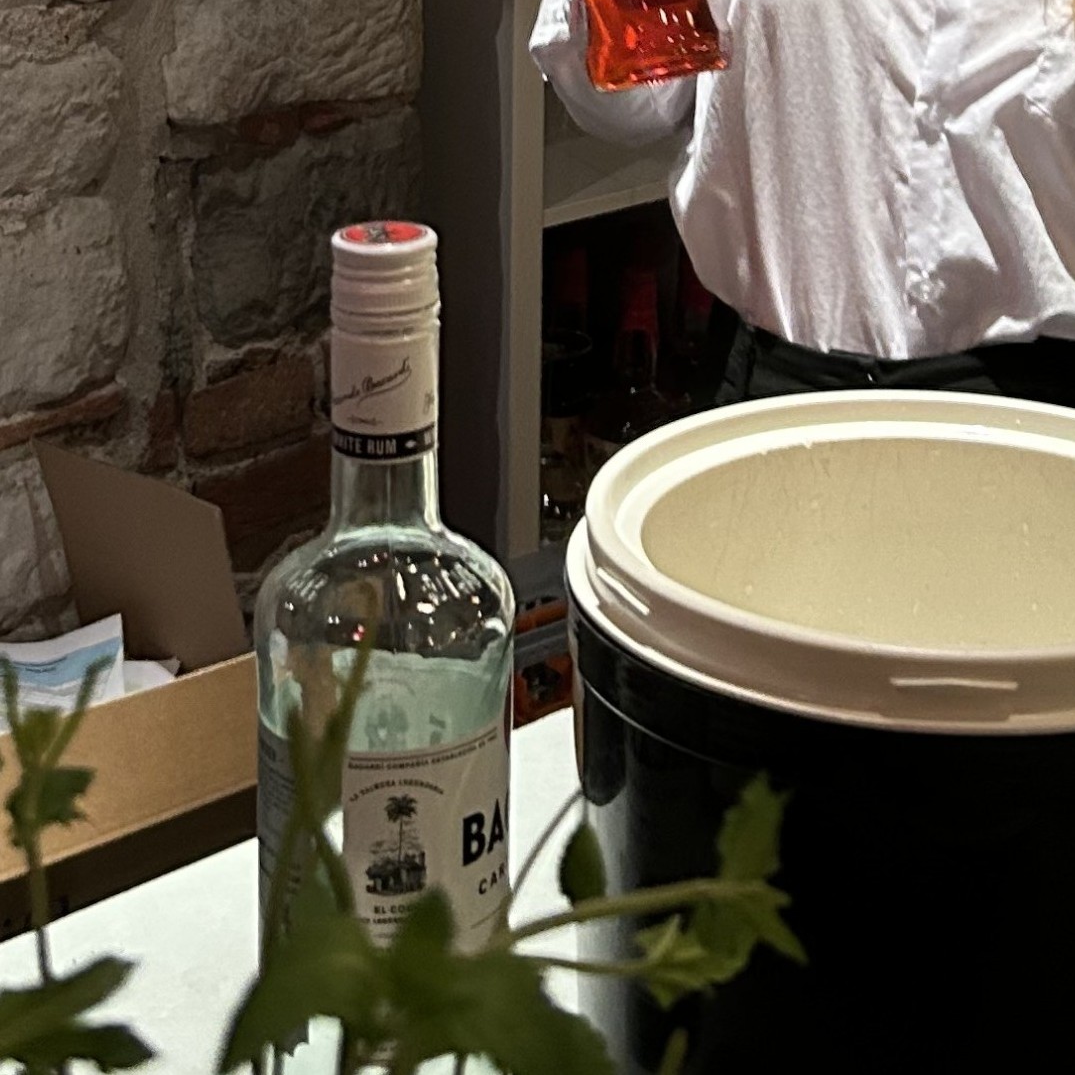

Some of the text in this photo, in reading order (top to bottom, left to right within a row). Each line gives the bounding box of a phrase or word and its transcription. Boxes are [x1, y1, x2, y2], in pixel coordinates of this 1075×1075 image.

[367, 437, 397, 455] RUM
[462, 791, 509, 867] BA
[478, 862, 507, 895] CAR
